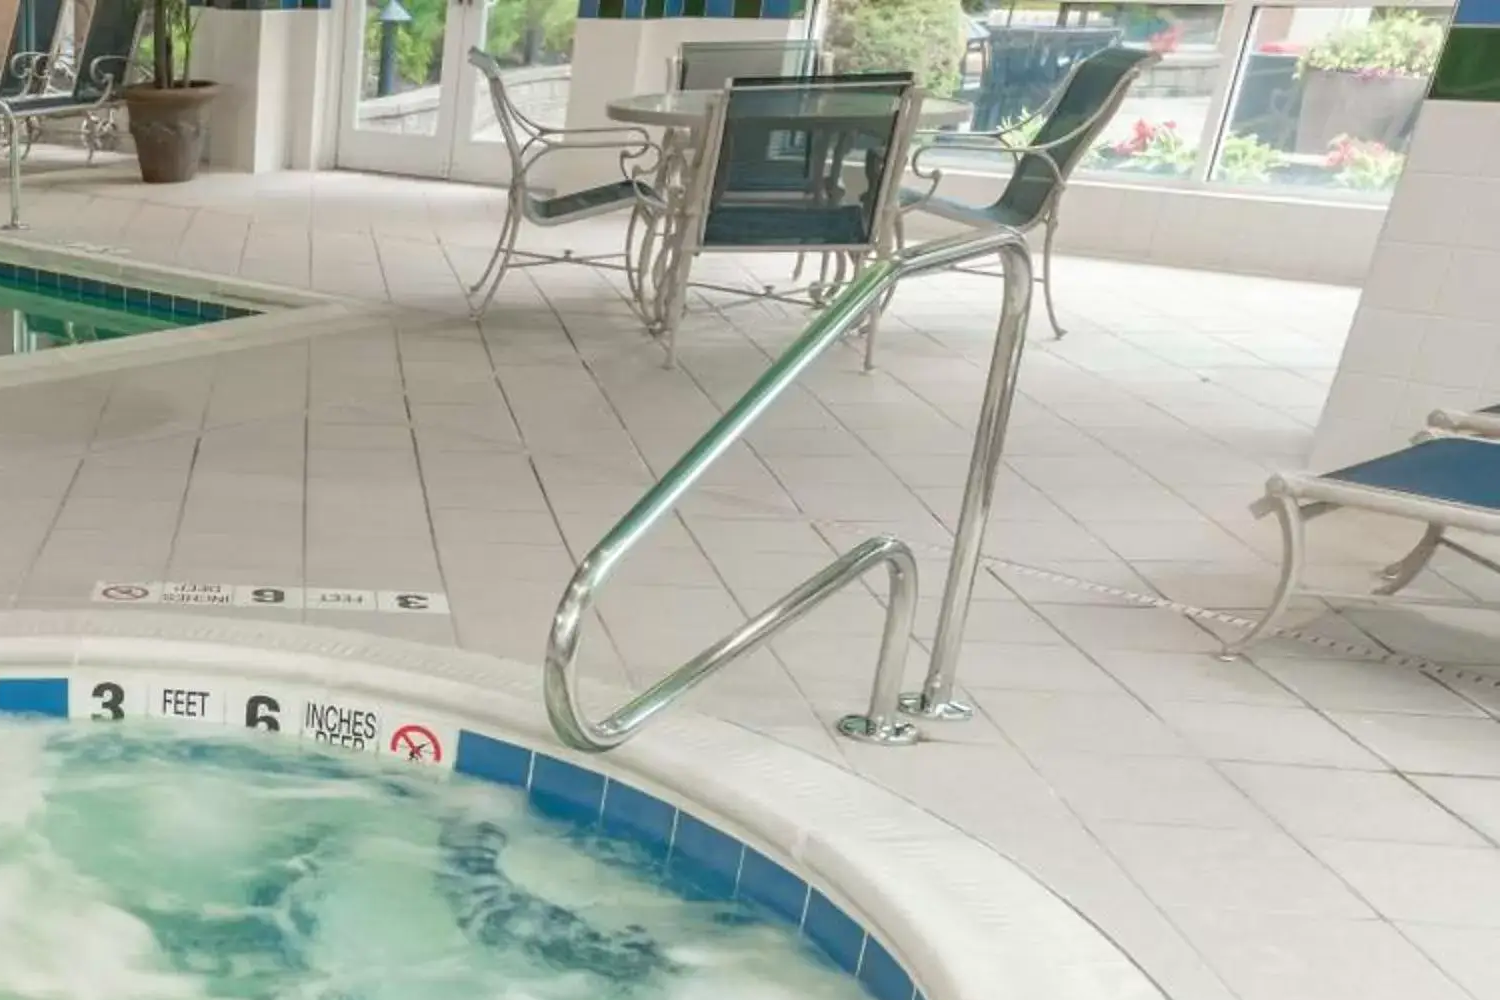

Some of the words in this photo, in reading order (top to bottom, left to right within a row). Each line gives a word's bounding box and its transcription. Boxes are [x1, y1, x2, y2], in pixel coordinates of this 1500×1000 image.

[252, 588, 286, 604] 6
[396, 594, 429, 609] 3
[91, 682, 125, 720] 3
[163, 689, 210, 717] FEET
[246, 695, 280, 732] 6
[306, 702, 377, 739] INCHES
